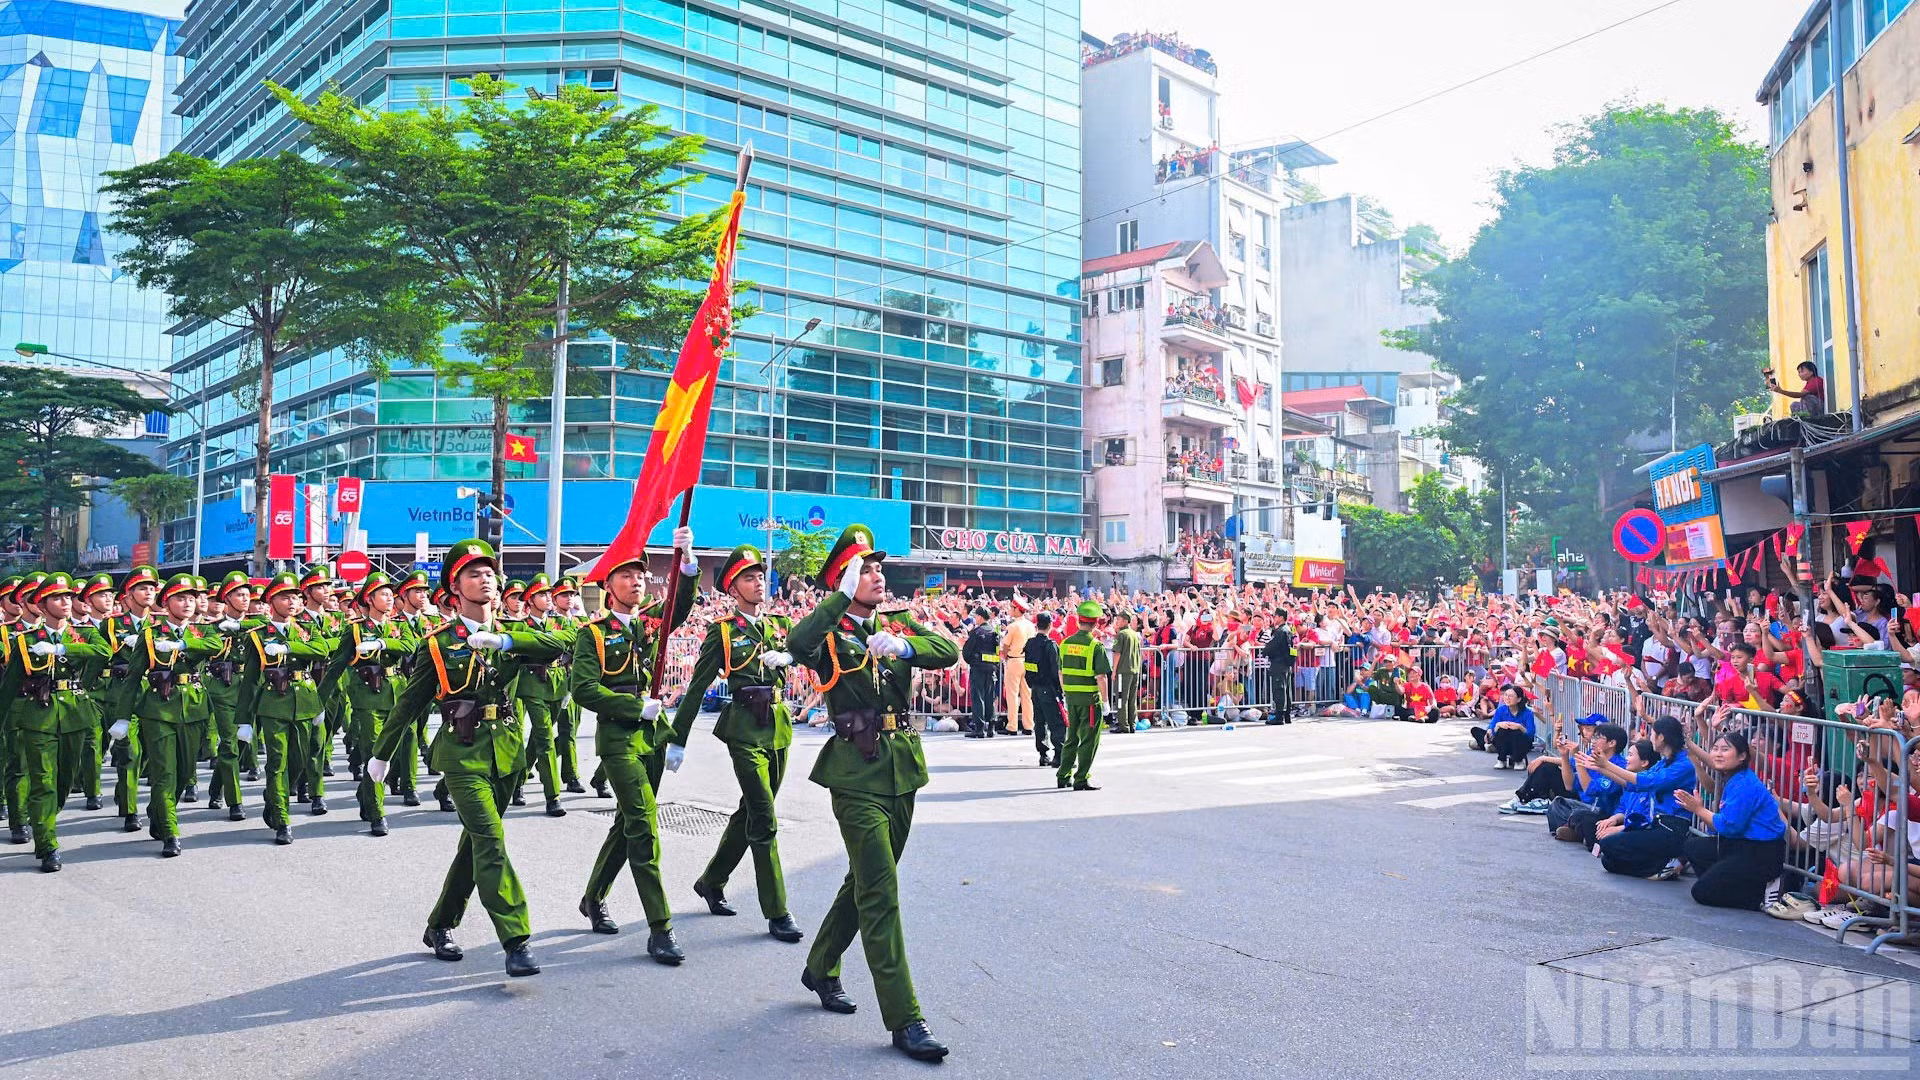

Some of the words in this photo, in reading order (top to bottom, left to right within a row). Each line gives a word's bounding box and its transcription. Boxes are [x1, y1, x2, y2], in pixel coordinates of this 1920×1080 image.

[1655, 466, 1700, 510] HANOI
[738, 513, 809, 531] VietBank
[1045, 535, 1092, 556] NAM
